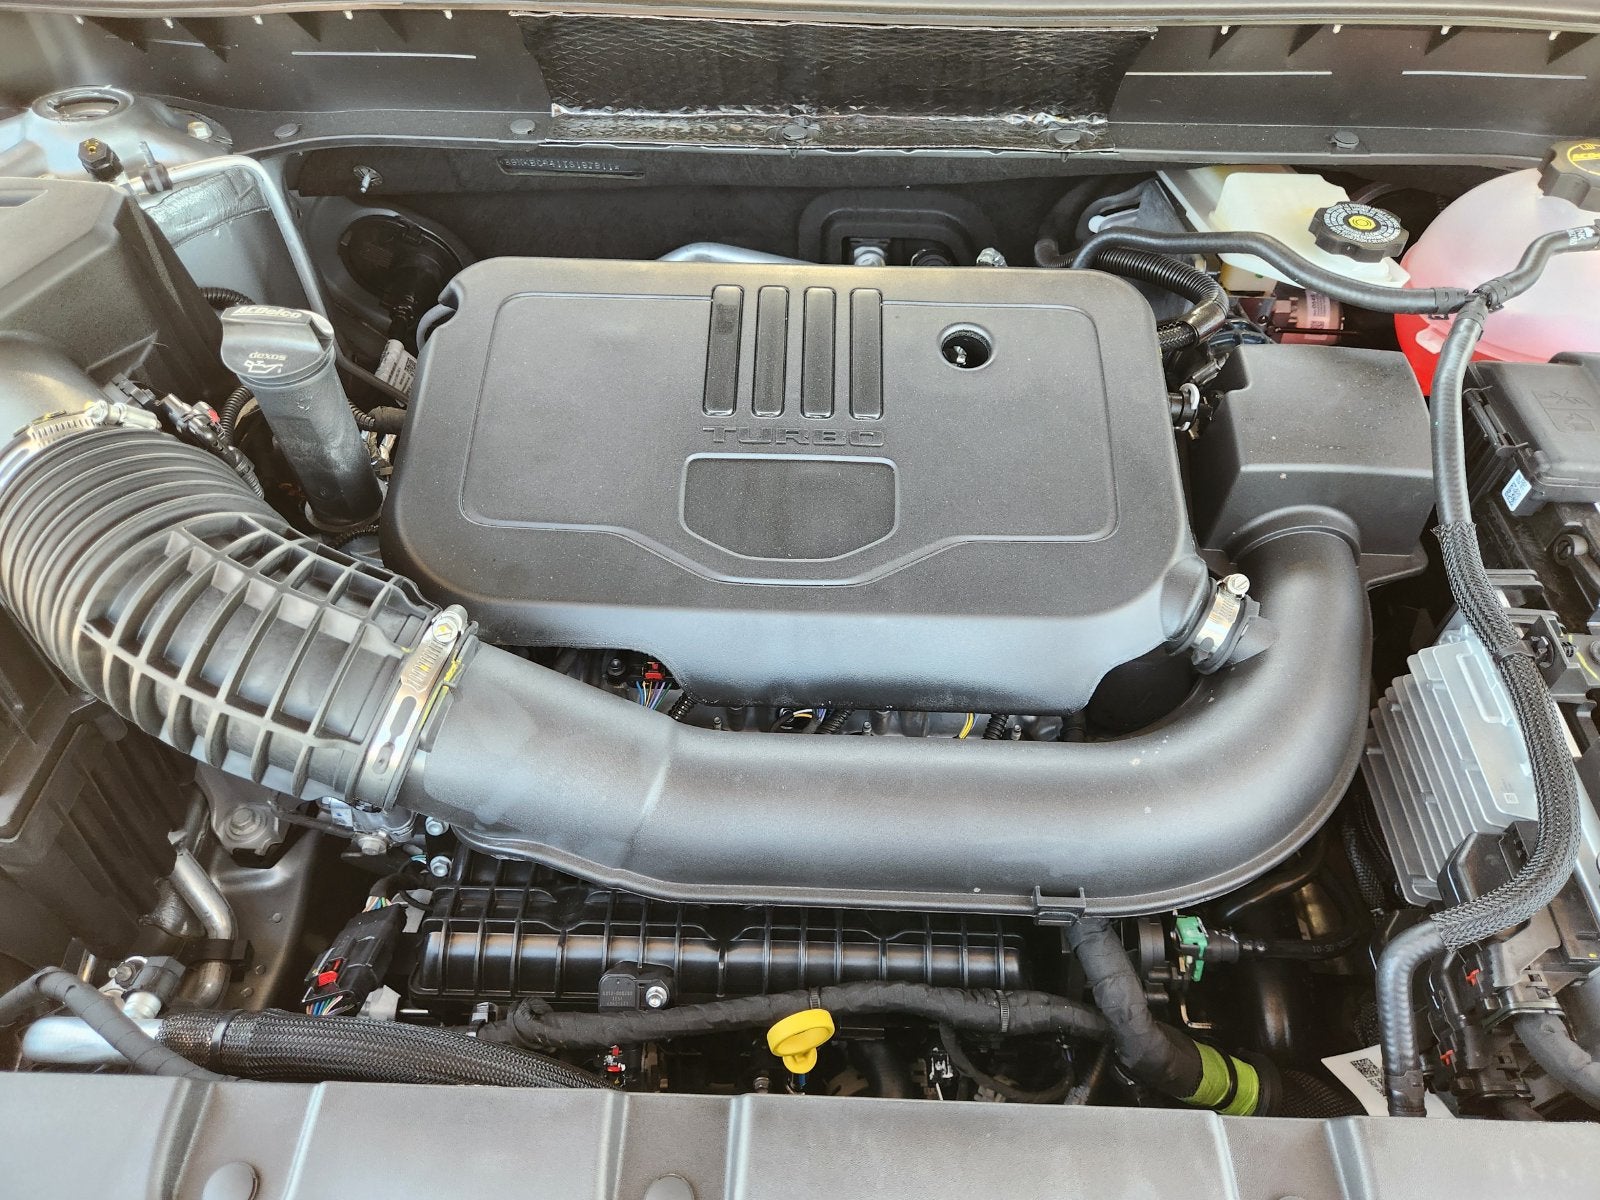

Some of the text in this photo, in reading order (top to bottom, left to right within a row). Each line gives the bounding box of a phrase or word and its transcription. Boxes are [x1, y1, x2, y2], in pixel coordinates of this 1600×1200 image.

[231, 305, 304, 320] ACDelco
[248, 351, 287, 361] dexos
[702, 426, 884, 447] TURBO
